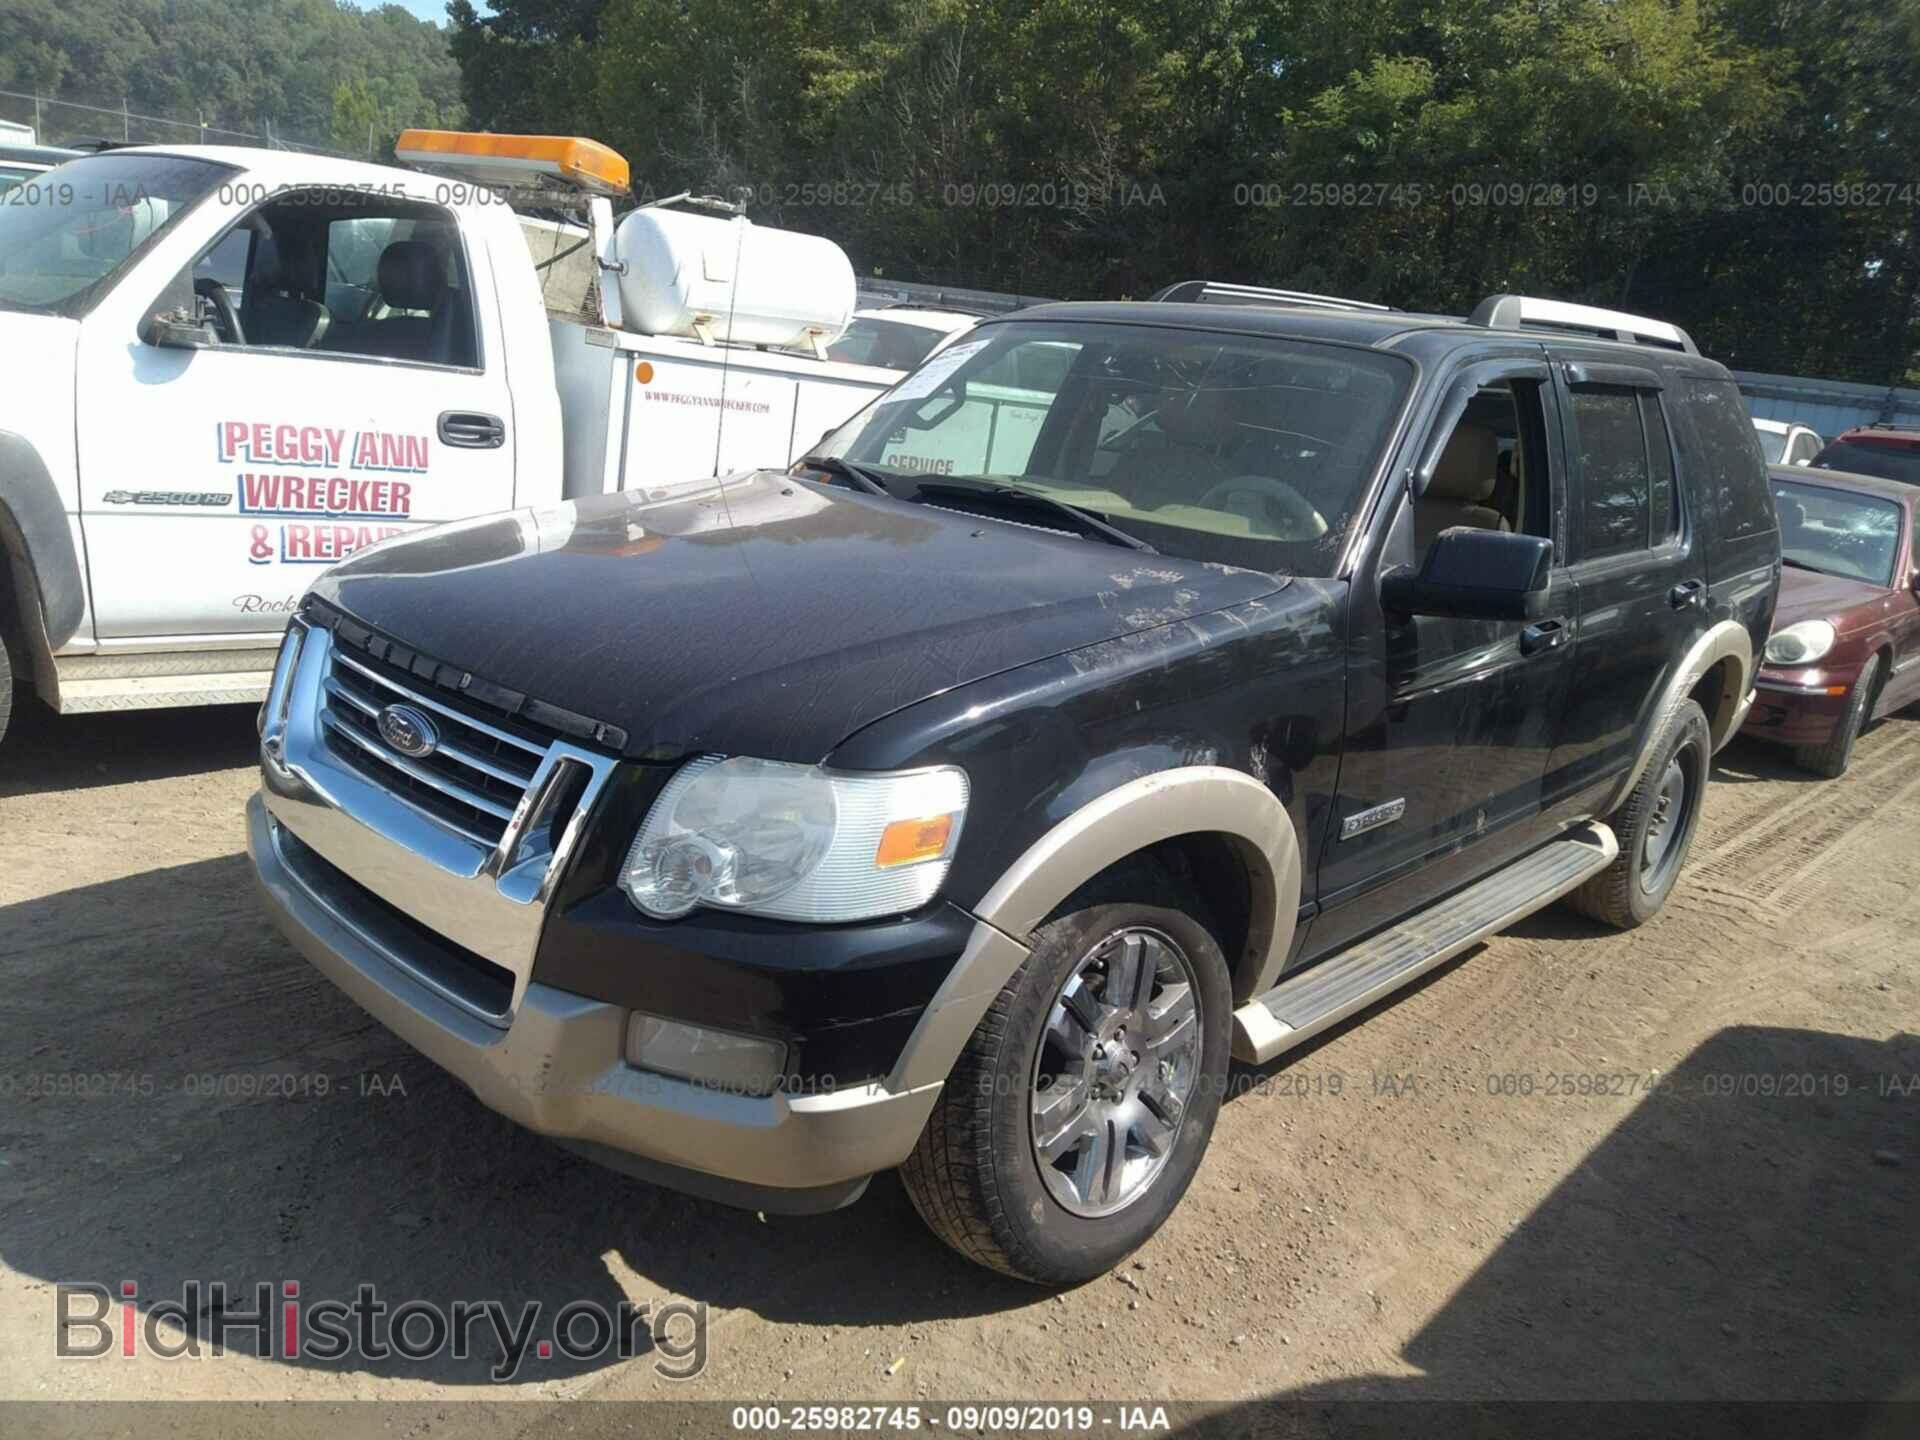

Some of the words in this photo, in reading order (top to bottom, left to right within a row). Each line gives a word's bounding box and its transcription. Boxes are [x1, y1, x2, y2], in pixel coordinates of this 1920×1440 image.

[217, 421, 344, 468] PEGGY
[350, 431, 428, 473] ANN
[237, 473, 411, 518] WRECKER
[248, 524, 274, 564] &
